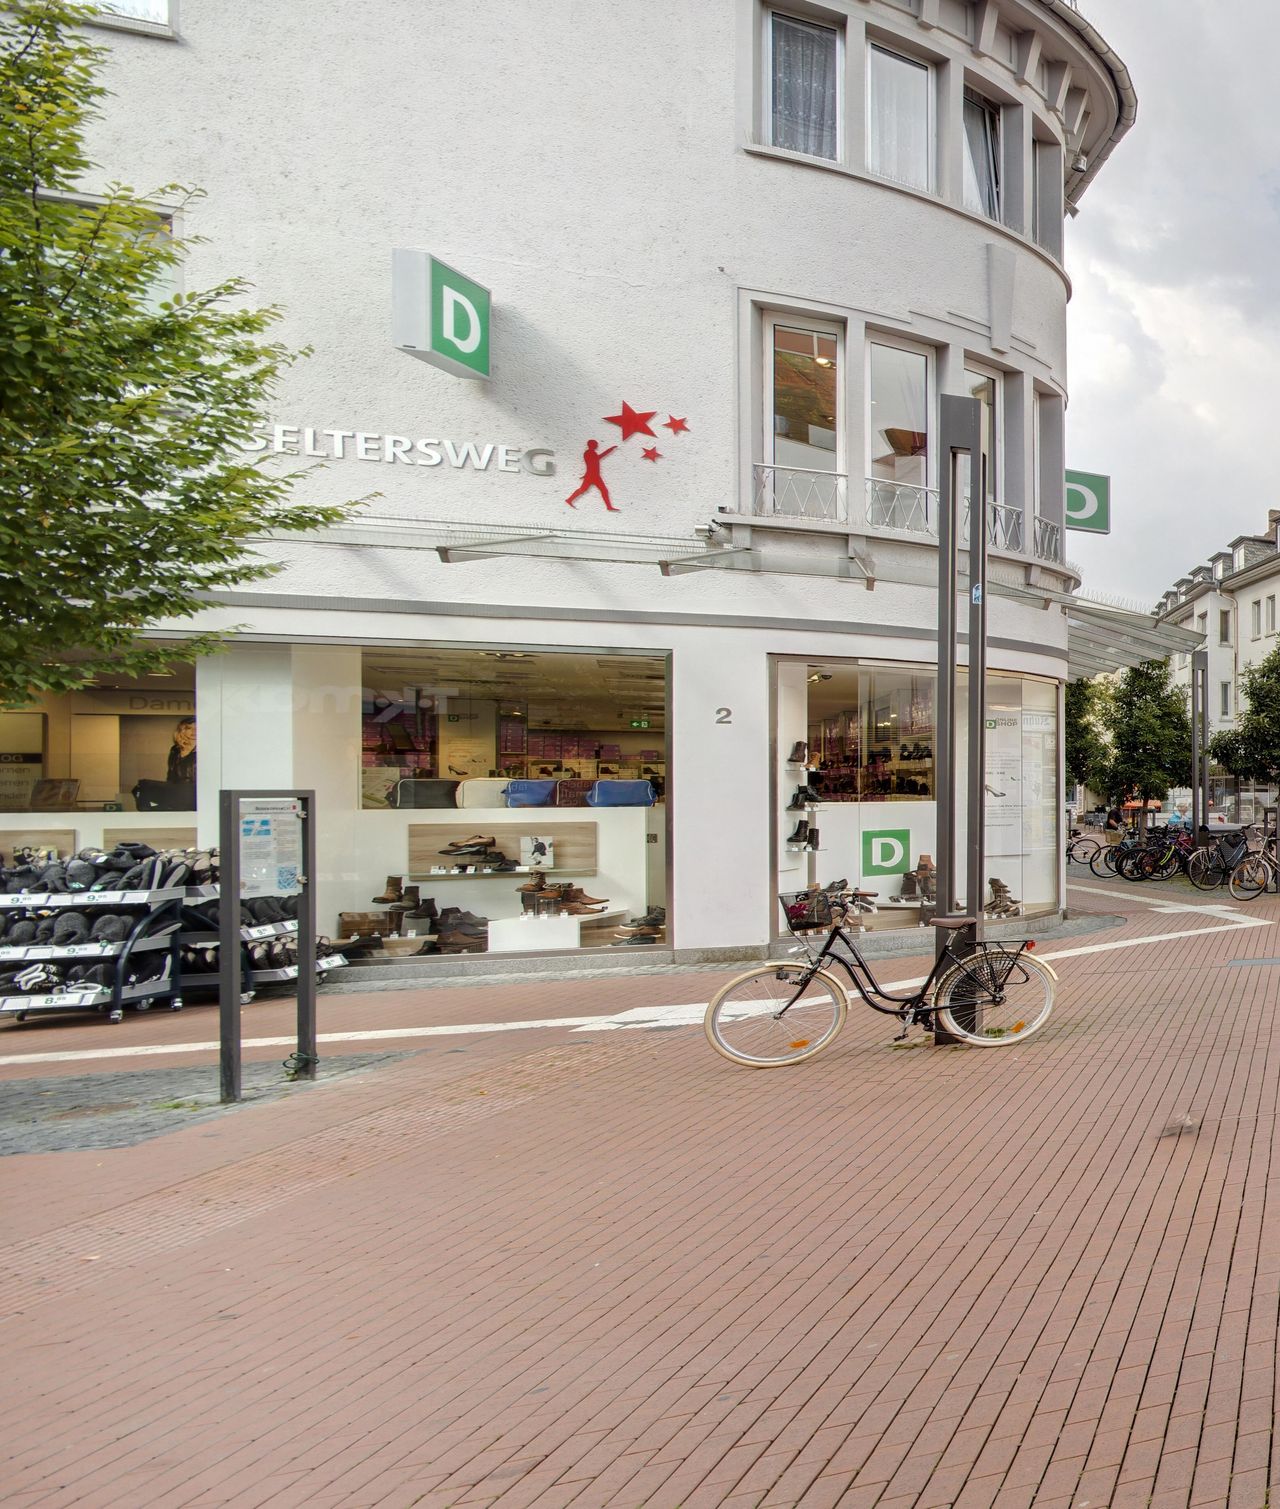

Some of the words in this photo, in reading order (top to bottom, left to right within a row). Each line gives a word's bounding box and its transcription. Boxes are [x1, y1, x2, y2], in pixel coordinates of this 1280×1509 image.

[442, 284, 481, 353] D
[715, 707, 732, 724] 2
[871, 837, 904, 868] D
